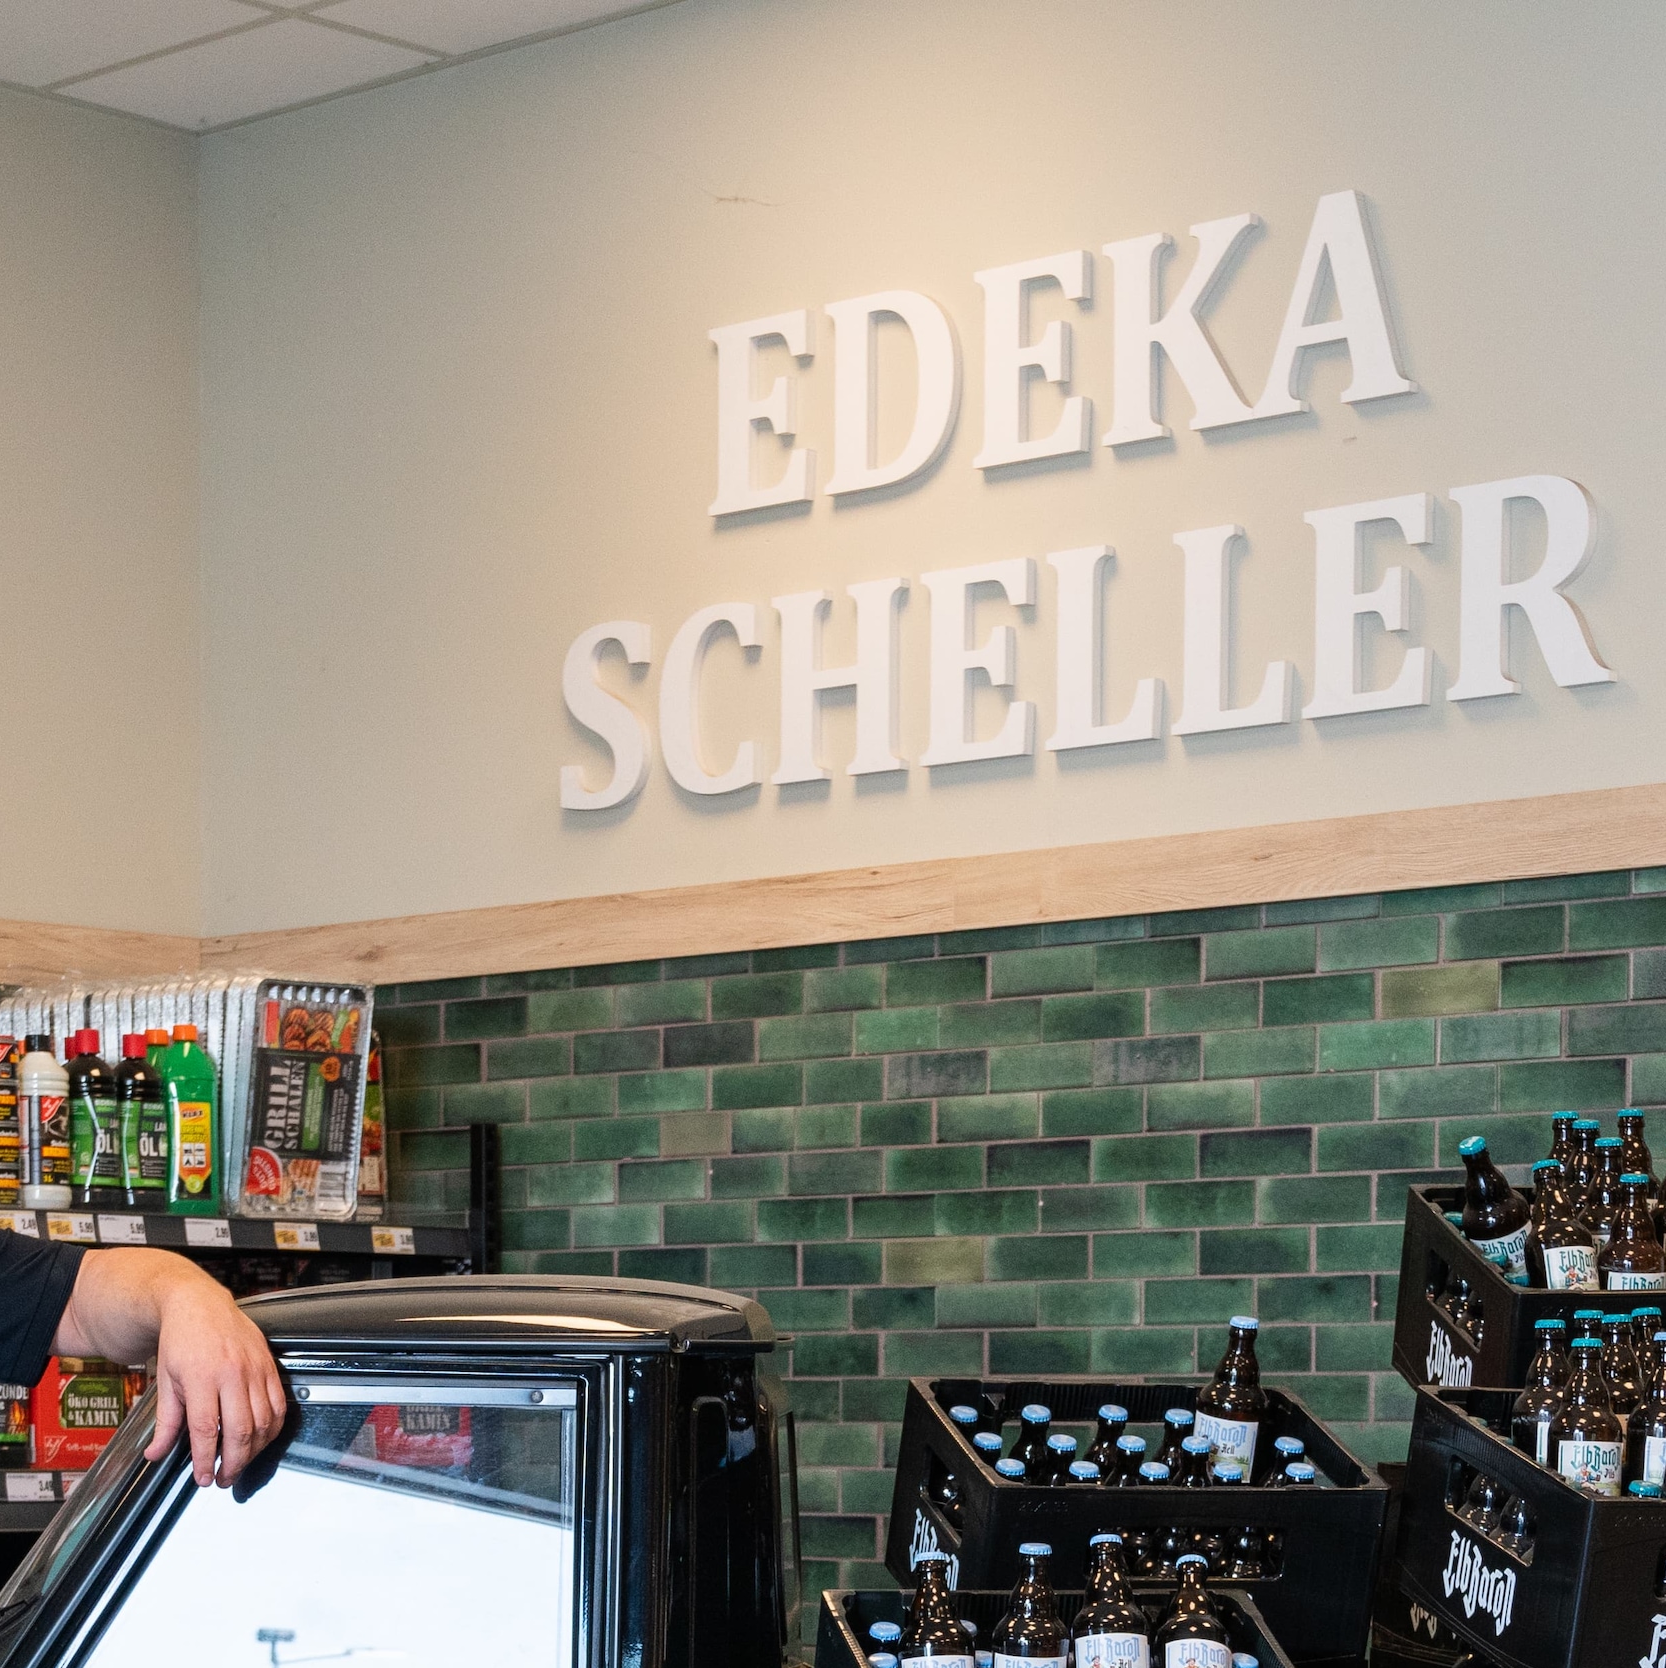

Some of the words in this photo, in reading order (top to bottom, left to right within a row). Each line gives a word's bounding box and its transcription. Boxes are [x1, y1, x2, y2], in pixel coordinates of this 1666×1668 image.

[708, 188, 1420, 518] EDEKA
[558, 473, 1620, 814] SCHELLER
[263, 1059, 292, 1150] GRILL
[283, 1060, 306, 1151] SCHALEN
[68, 1393, 88, 1409] ÖKO
[89, 1397, 120, 1409] GRILL
[74, 1410, 120, 1426] KAMIN
